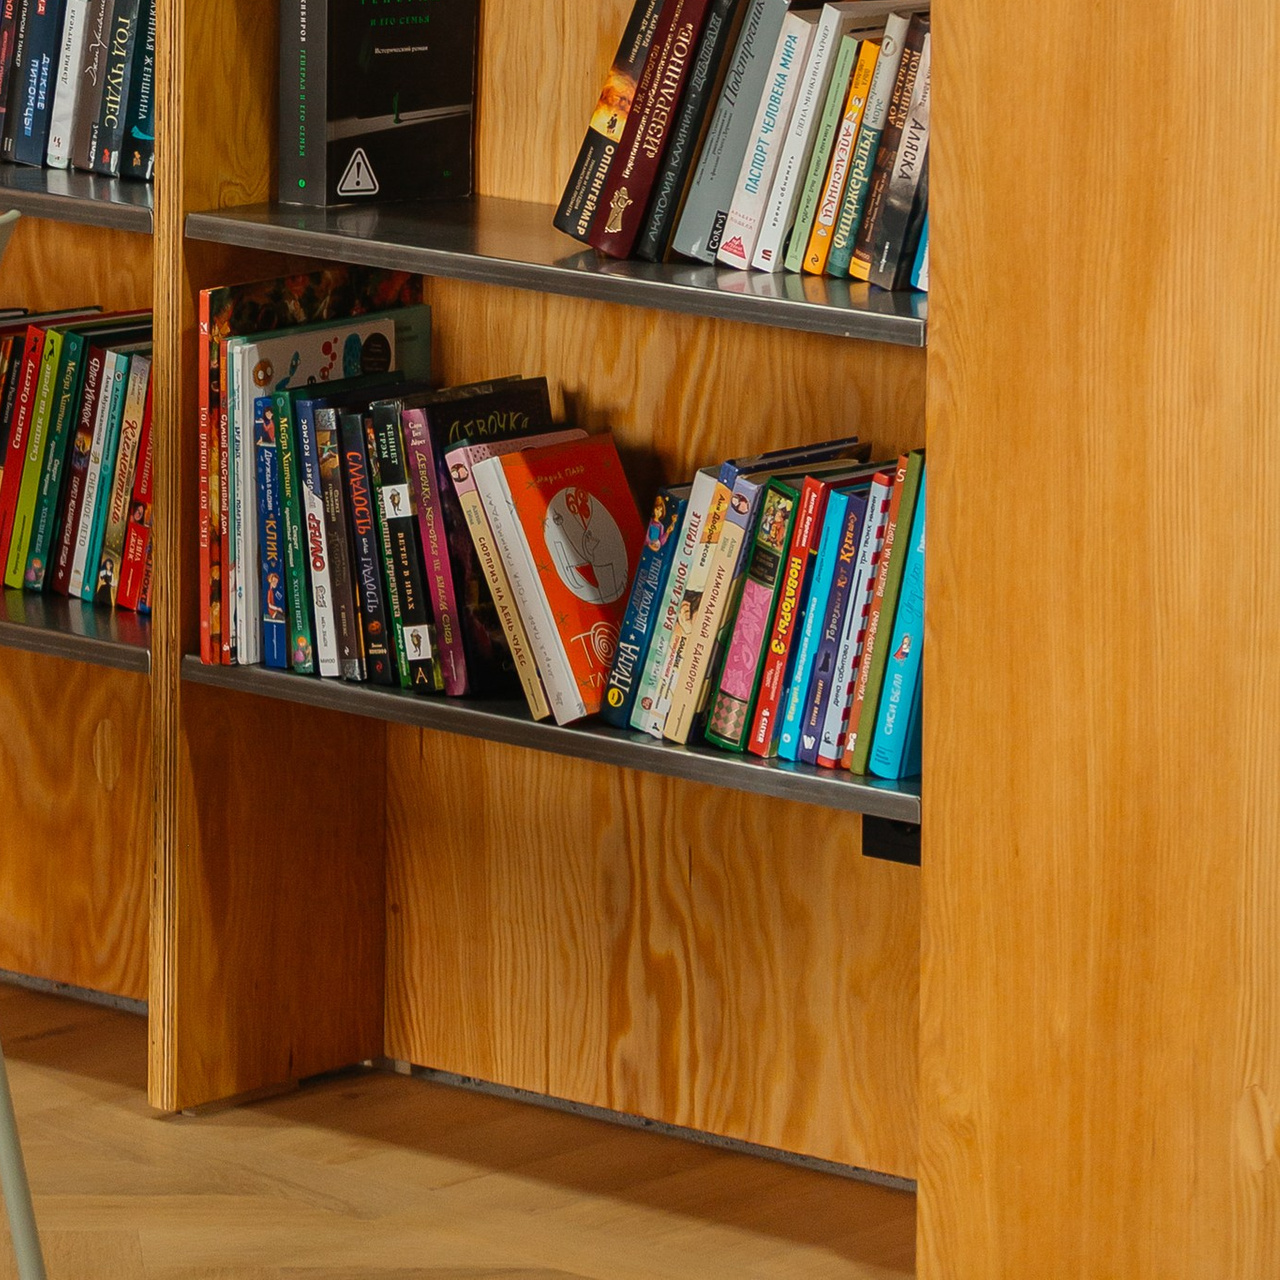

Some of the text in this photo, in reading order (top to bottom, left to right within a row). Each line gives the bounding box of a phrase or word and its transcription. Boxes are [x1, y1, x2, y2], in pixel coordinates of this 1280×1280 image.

[104, 16, 130, 129] ГОД ЧУДЕС
[744, 34, 799, 194] ПАСПОРТ ЧЕЛОВЕКА МИРА
[575, 144, 616, 236] ОППЕНГЕЙМЕР
[832, 127, 874, 249] Фицджеральд
[12, 359, 35, 449] Спасти Одетту
[78, 471, 97, 547] СНЕЖНОЕ ЛЕТО
[397, 532, 409, 566] ВЕТЕР
[404, 580, 415, 610] ИВАХ
[662, 511, 701, 631] ВАФЕЛЬНОЕ СЕРДЦЕ
[684, 565, 725, 695] ЛИМОНАДНЫЙ ЕДИНОРОГ
